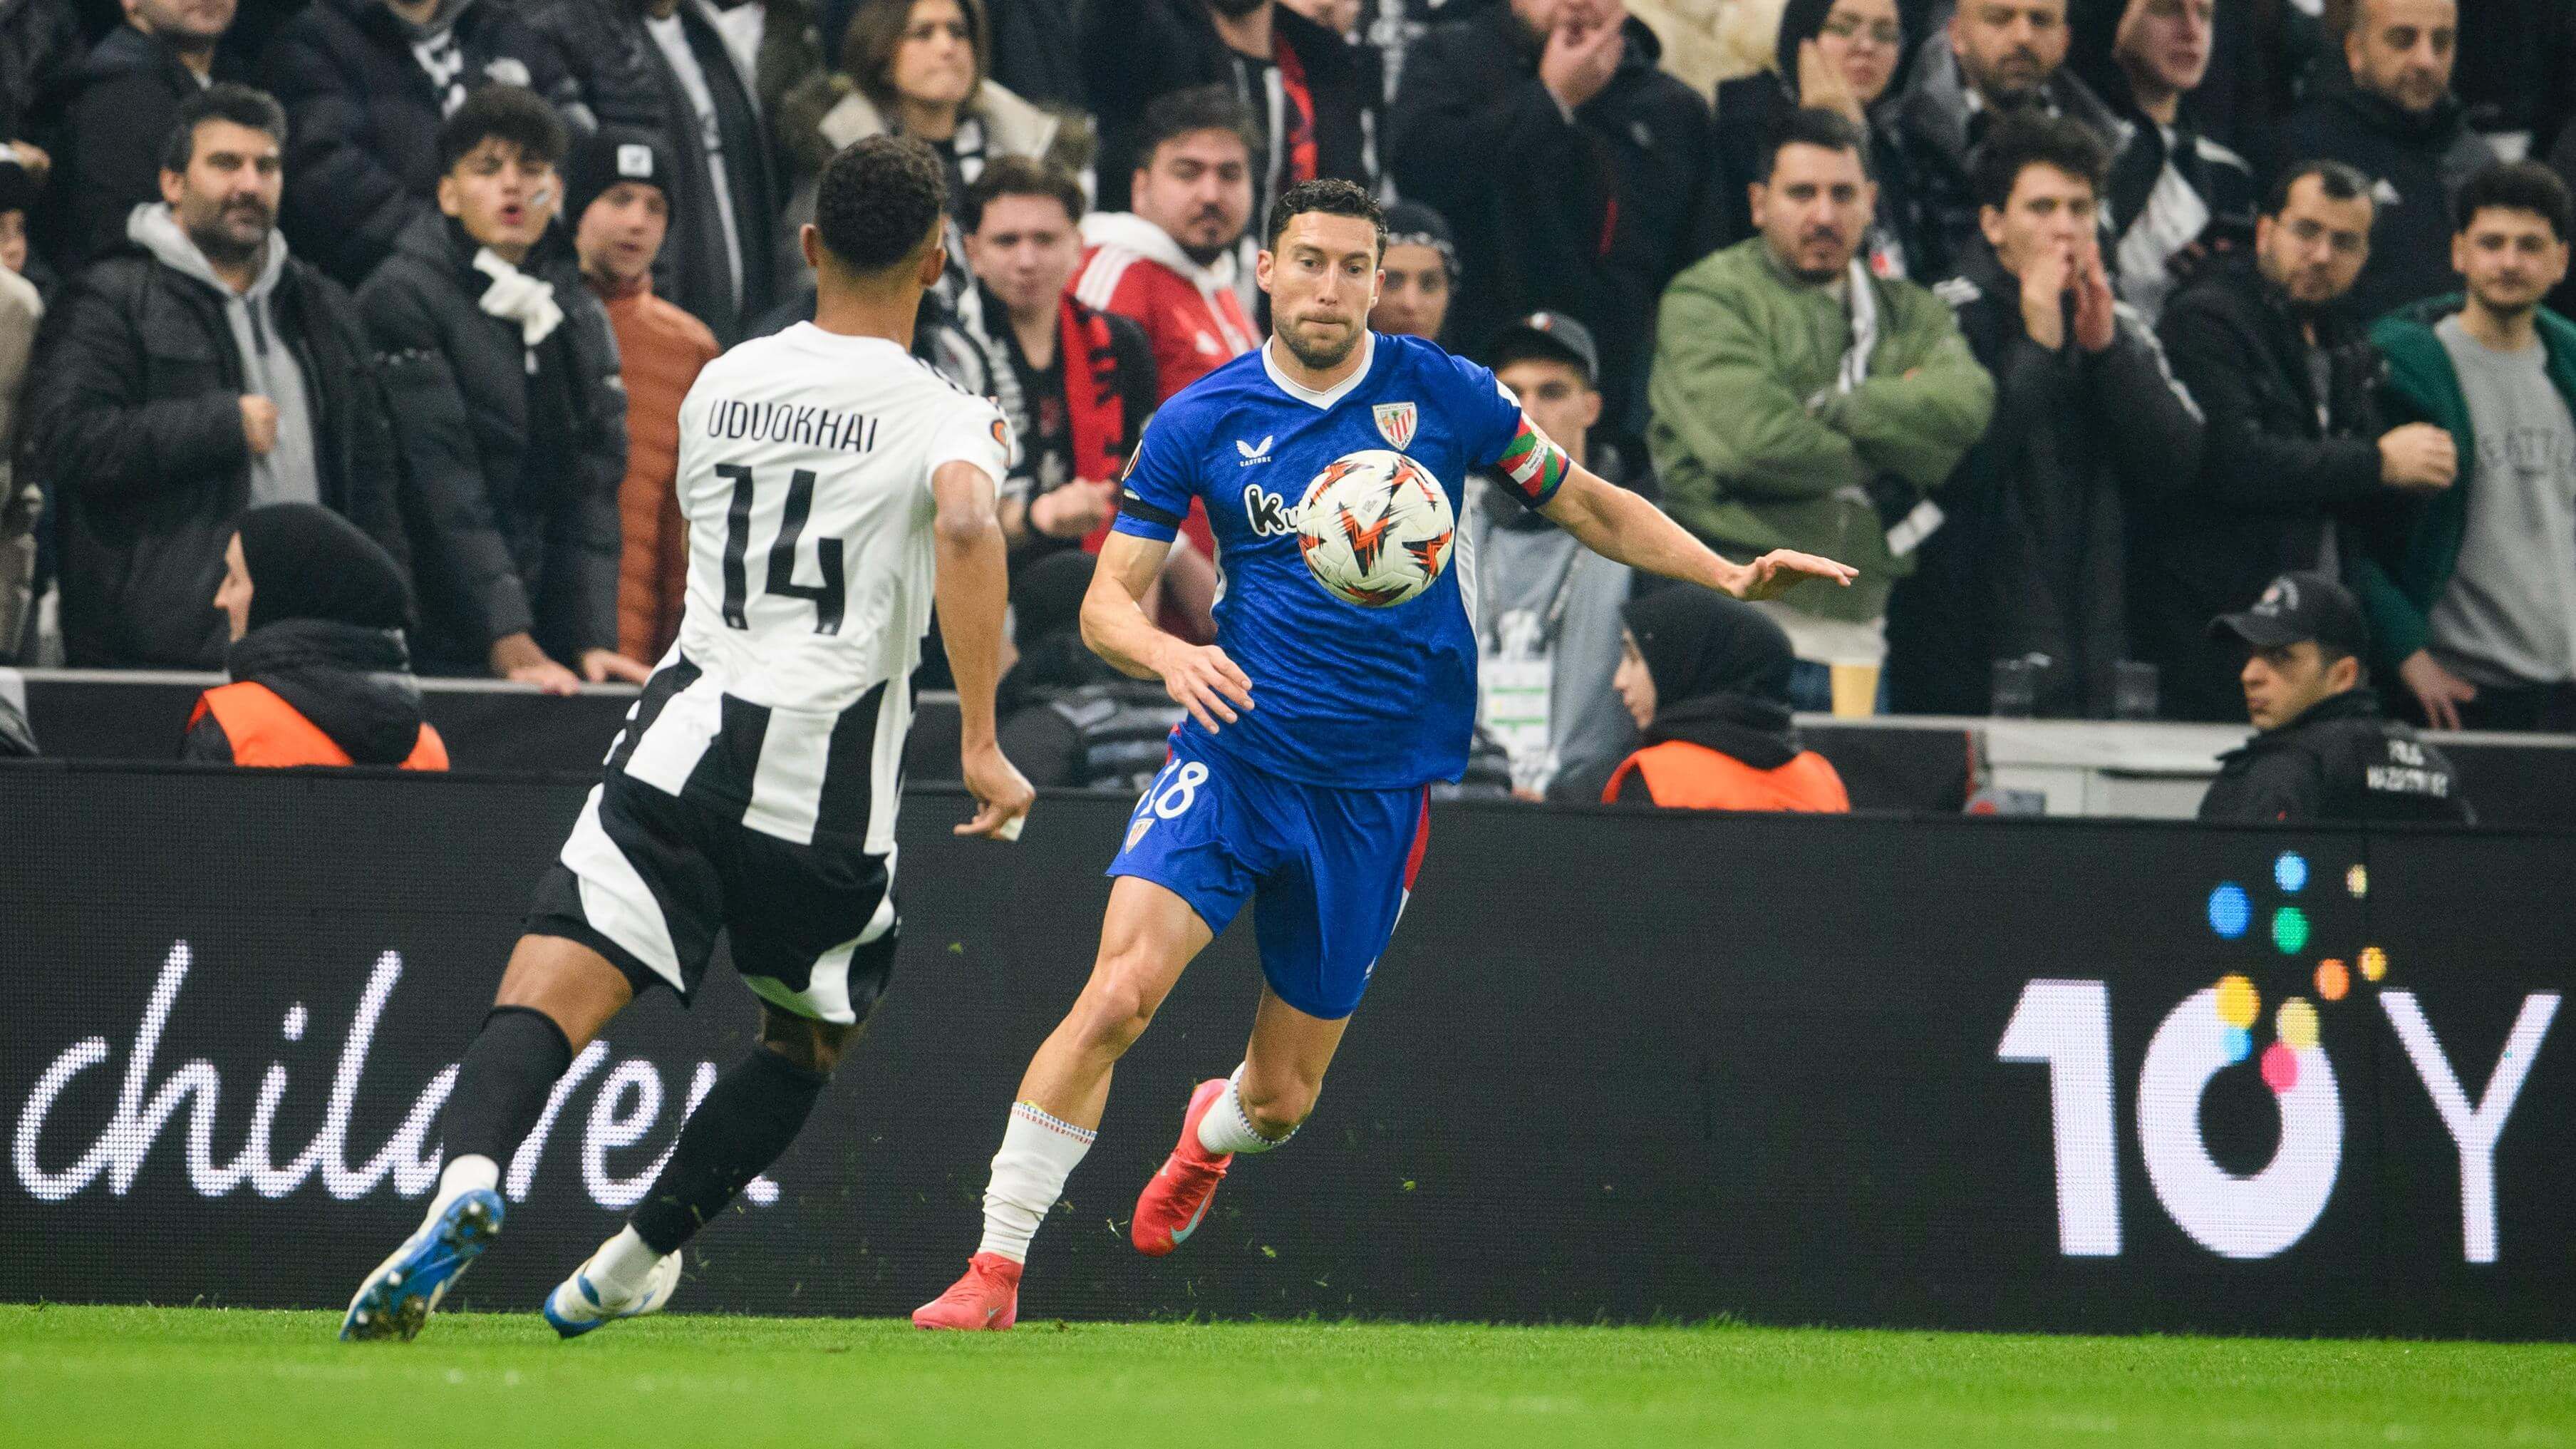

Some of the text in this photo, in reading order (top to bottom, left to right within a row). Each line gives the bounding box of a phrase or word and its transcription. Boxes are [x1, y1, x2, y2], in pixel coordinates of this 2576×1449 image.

[708, 399, 879, 453] UDUOKHAI
[1240, 456, 1272, 468] CASTORE
[714, 463, 846, 636] 14
[1139, 758, 1209, 819] 18
